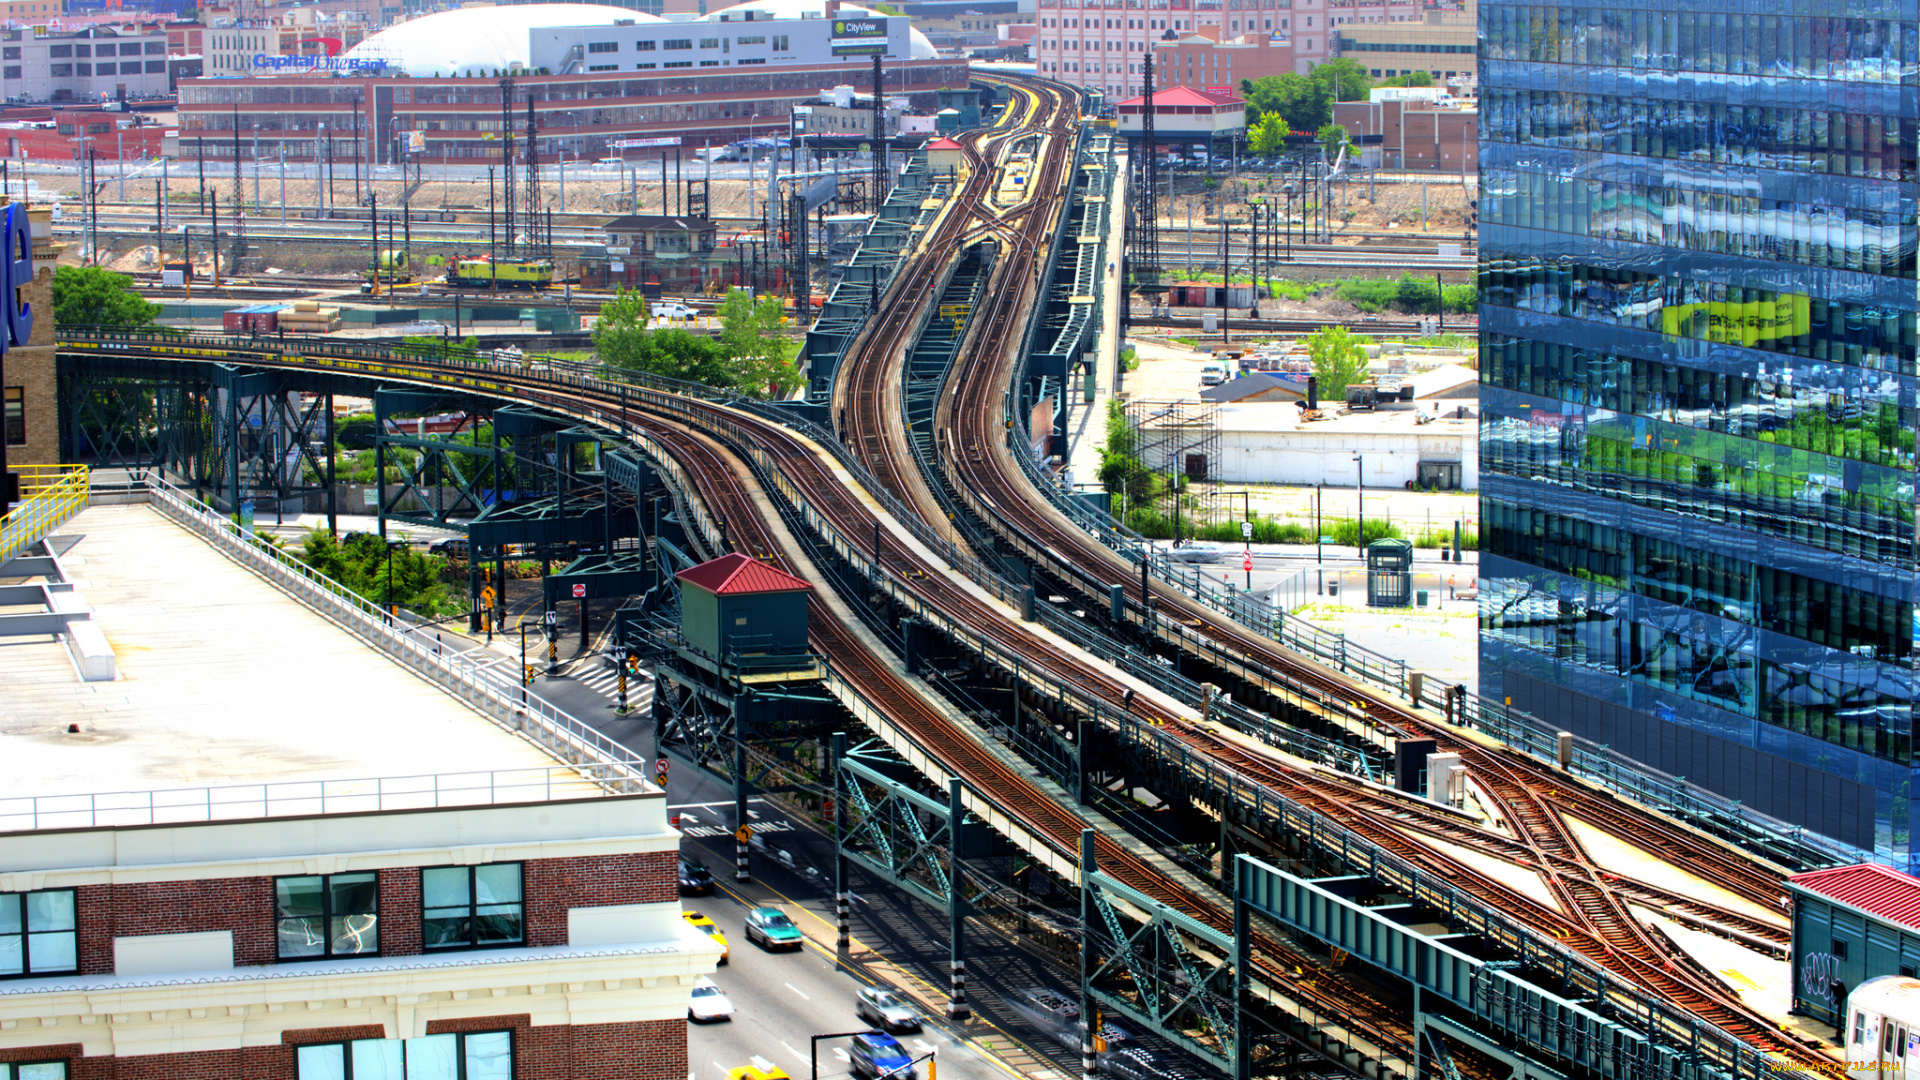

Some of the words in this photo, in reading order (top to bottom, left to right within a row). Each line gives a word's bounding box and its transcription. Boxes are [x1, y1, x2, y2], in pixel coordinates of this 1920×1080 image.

[846, 22, 876, 34] CityView
[683, 825, 734, 837] ONLY
[747, 821, 796, 833] ONLY
